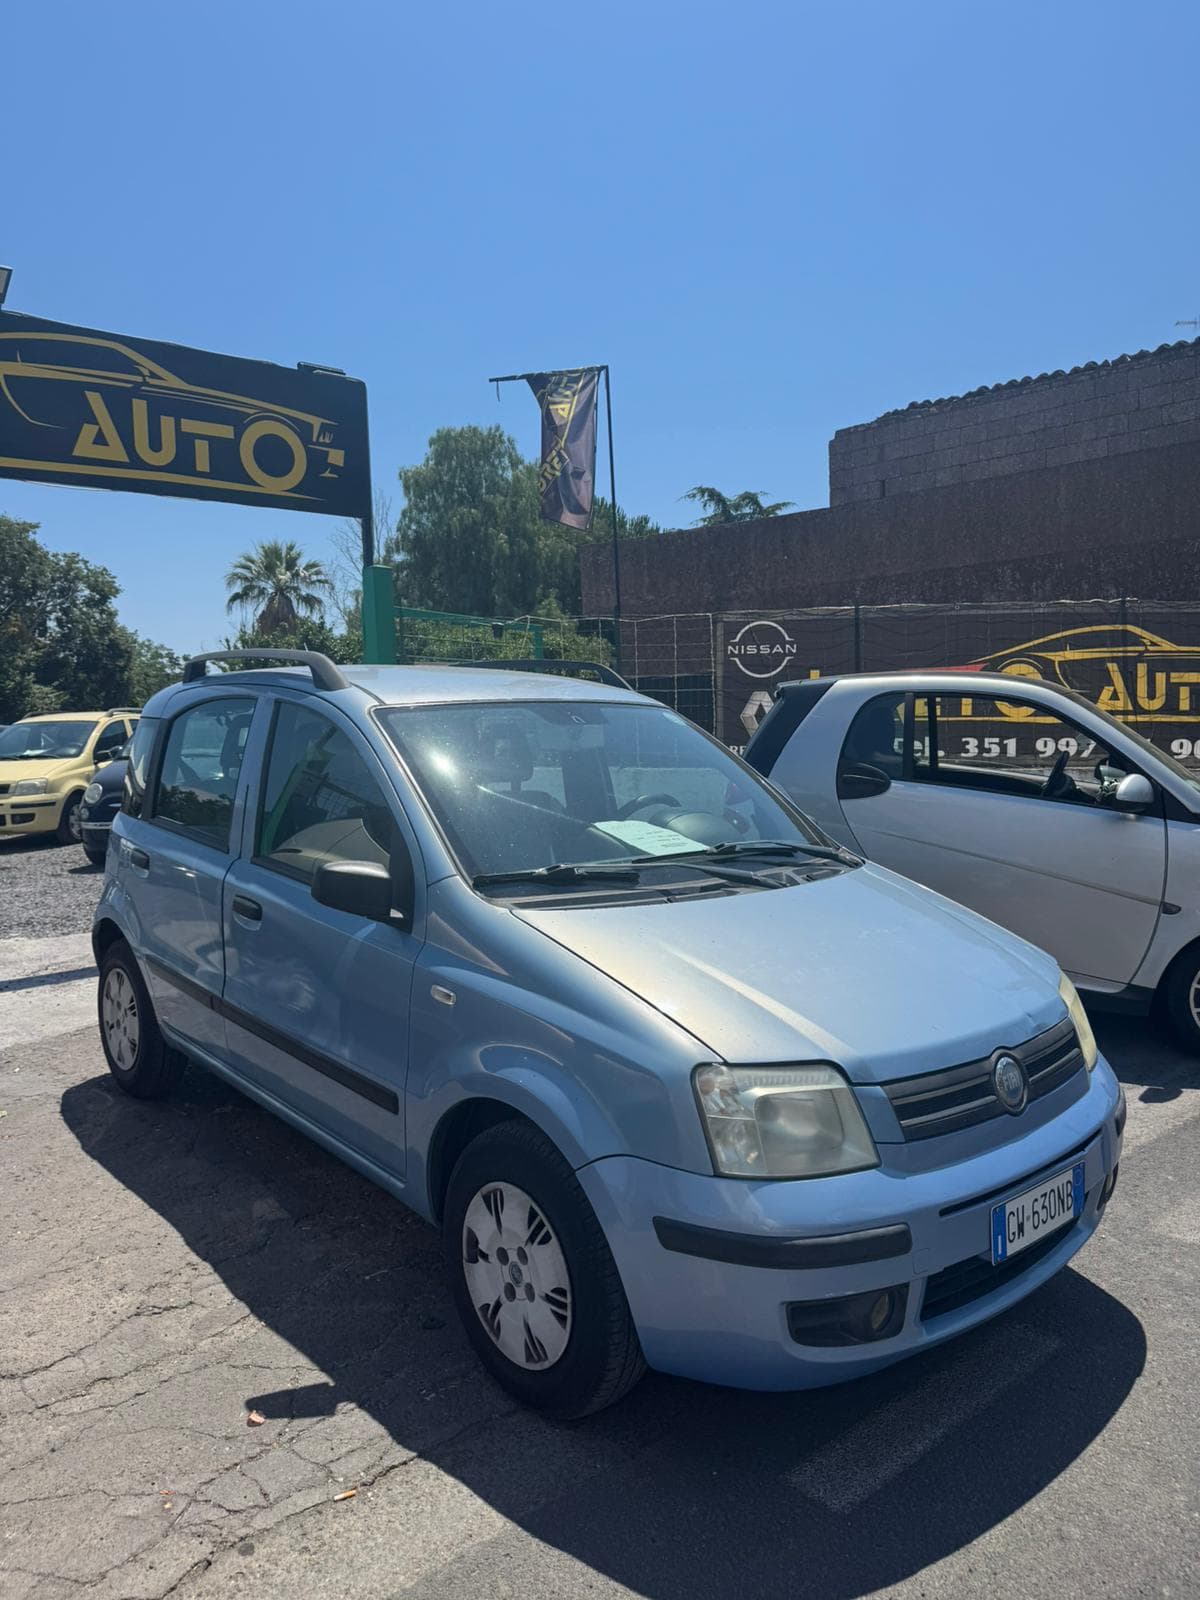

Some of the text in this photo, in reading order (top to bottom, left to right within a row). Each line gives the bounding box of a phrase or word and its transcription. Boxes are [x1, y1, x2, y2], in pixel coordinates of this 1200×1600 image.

[72, 390, 308, 491] AUTO
[727, 643, 797, 654] NISSAN
[961, 737, 1017, 759] 351
